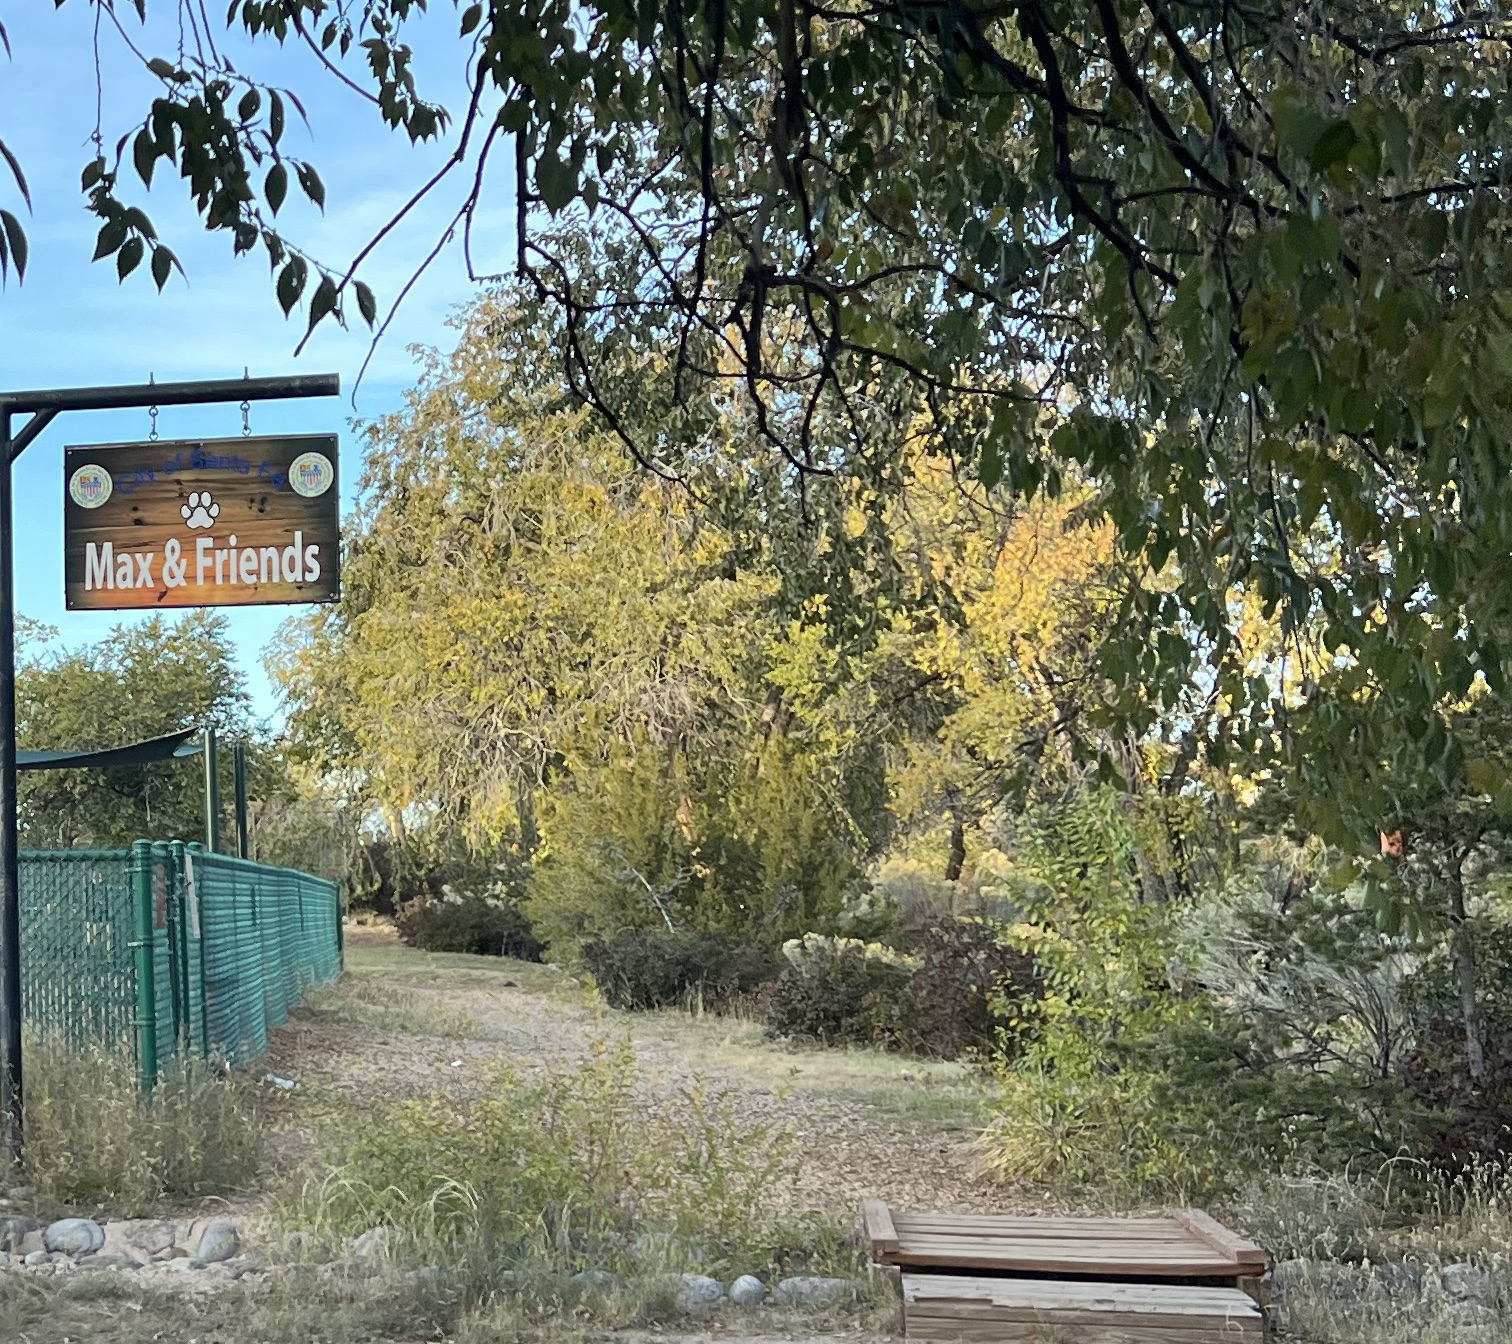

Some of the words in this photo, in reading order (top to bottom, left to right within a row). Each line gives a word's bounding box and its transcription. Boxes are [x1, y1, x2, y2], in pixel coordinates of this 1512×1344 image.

[84, 541, 154, 591] Max
[161, 538, 187, 588] &
[196, 530, 321, 586] Friends
